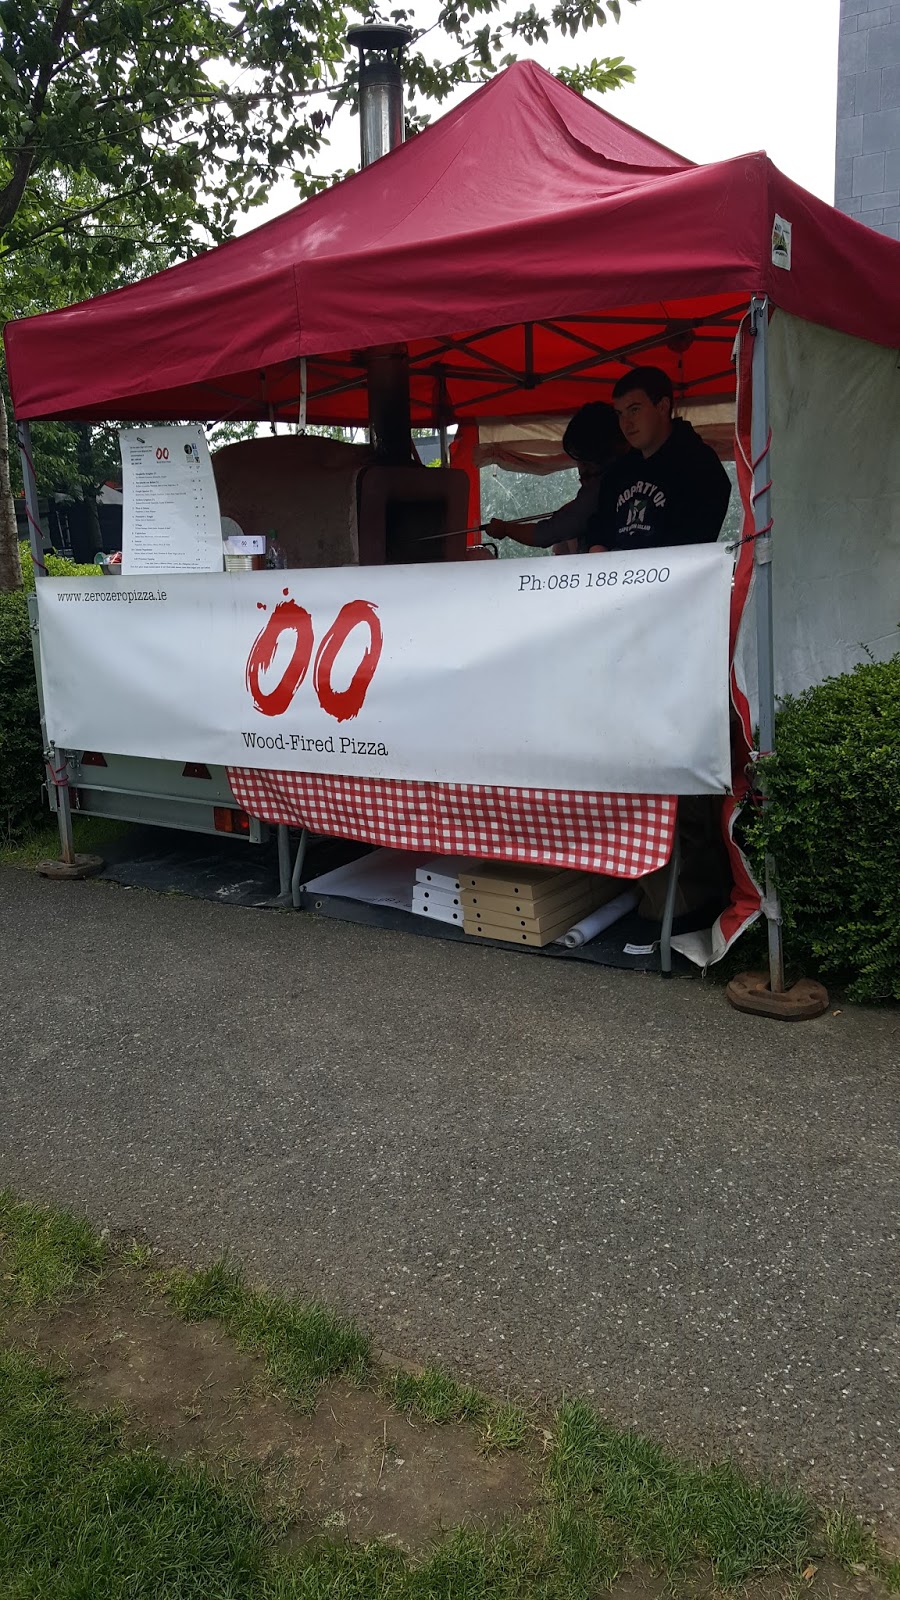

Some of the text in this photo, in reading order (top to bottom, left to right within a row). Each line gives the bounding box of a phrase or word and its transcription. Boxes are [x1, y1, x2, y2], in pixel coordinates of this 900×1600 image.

[616, 480, 658, 513] ROPRTY
[585, 571, 618, 588] 188
[622, 567, 670, 586] 2200
[57, 589, 168, 604] www.zerozeropizza.ie
[241, 732, 389, 757] Wood-Fired Pizza
